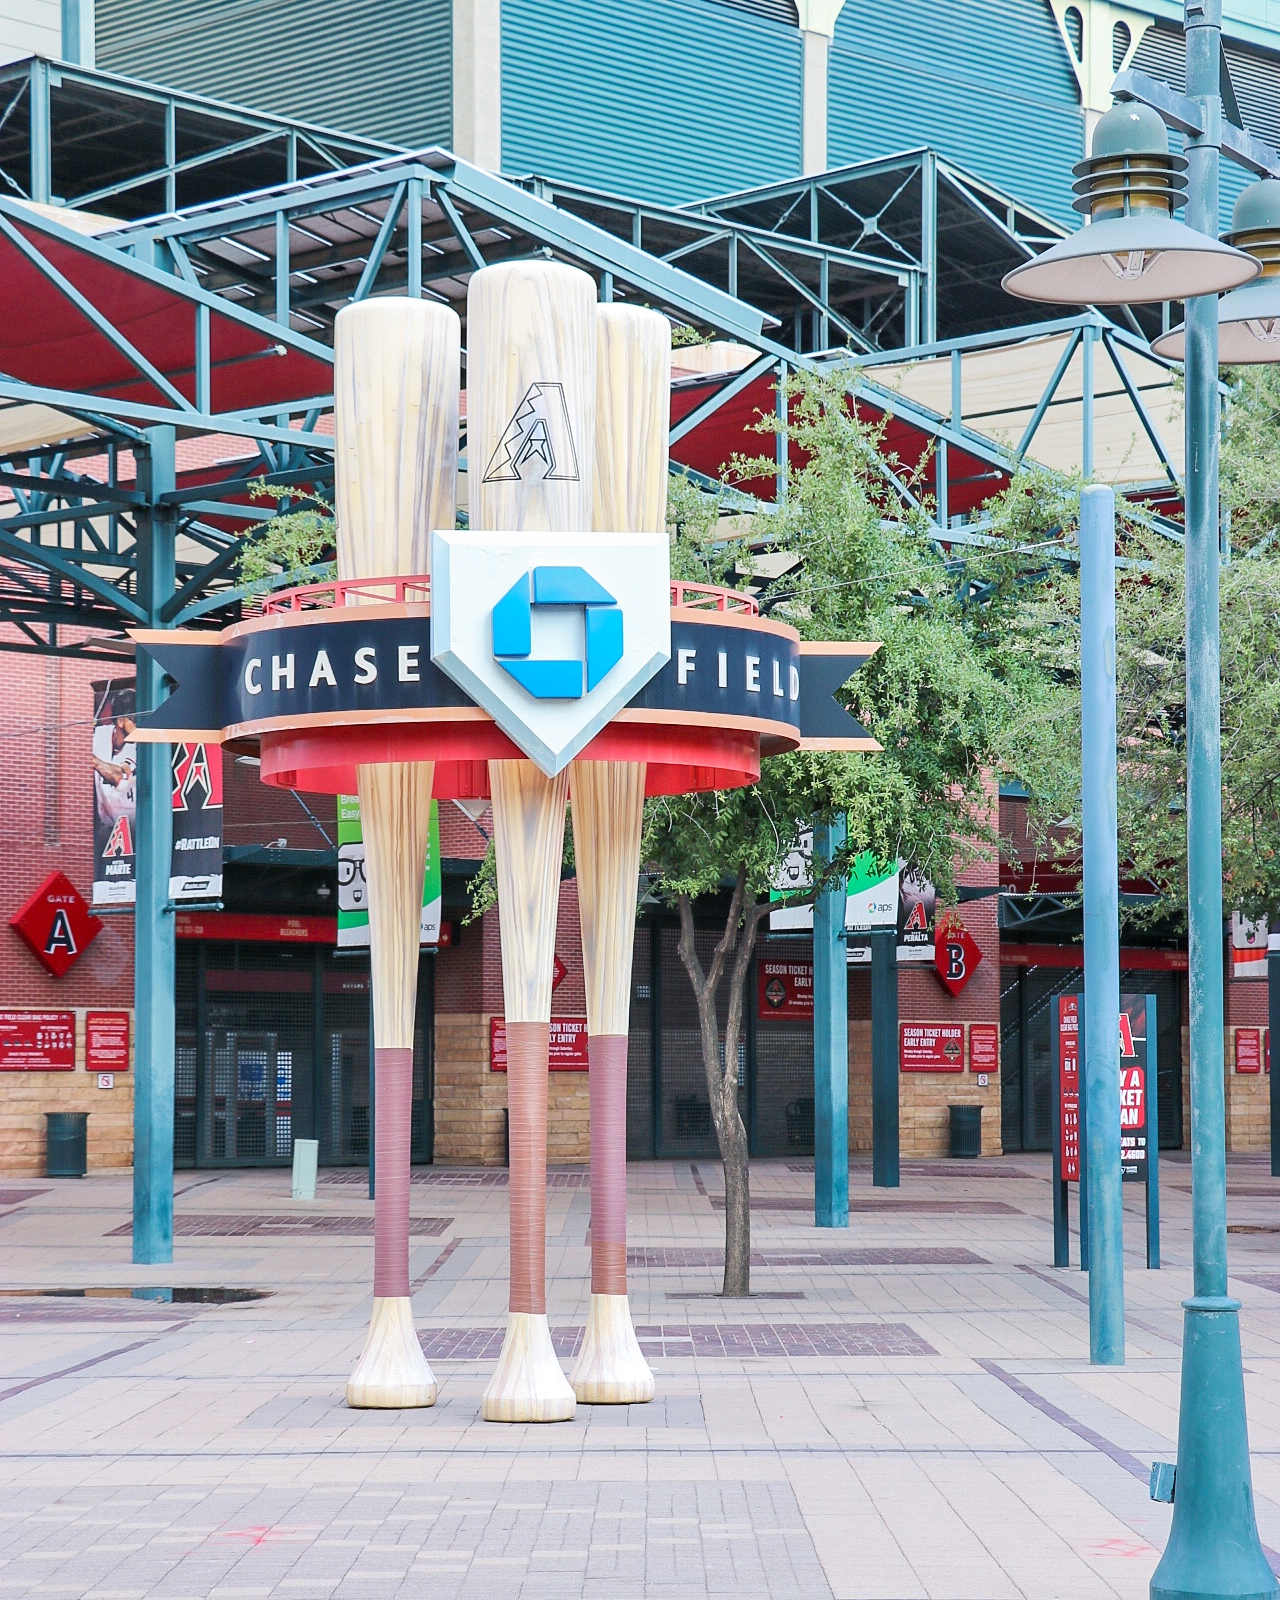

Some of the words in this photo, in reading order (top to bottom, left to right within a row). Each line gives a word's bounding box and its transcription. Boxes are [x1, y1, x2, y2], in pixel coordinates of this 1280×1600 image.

[245, 646, 421, 695] CHASE
[678, 649, 800, 701] FIELD
[340, 795, 360, 805] Brea
[175, 836, 220, 850] #RATTLEON
[105, 863, 132, 875] MARTE
[47, 895, 76, 904] GATE
[877, 902, 893, 913] aps
[43, 909, 78, 955] A
[423, 924, 437, 933] aps
[903, 934, 929, 943] PERALTA
[946, 943, 966, 980] B
[765, 964, 788, 975] SEASON
[788, 965, 808, 976] TICKET
[795, 977, 813, 987] EARLY
[549, 1023, 562, 1033] SON
[562, 1023, 582, 1033] TICKET
[904, 1028, 923, 1037] SEASON
[924, 1028, 941, 1037] TICKET
[942, 1029, 961, 1037] HOLDER
[557, 1033, 577, 1043] ENTRY
[904, 1038, 919, 1046] EARLY
[920, 1038, 936, 1046] ENTRY
[1129, 1070, 1141, 1087] A
[1120, 1088, 1144, 1106] KET
[1120, 1107, 1139, 1125] AN
[1120, 1136, 1136, 1147] ATS
[1137, 1137, 1147, 1147] TO
[1120, 1149, 1146, 1160] 2.4600
